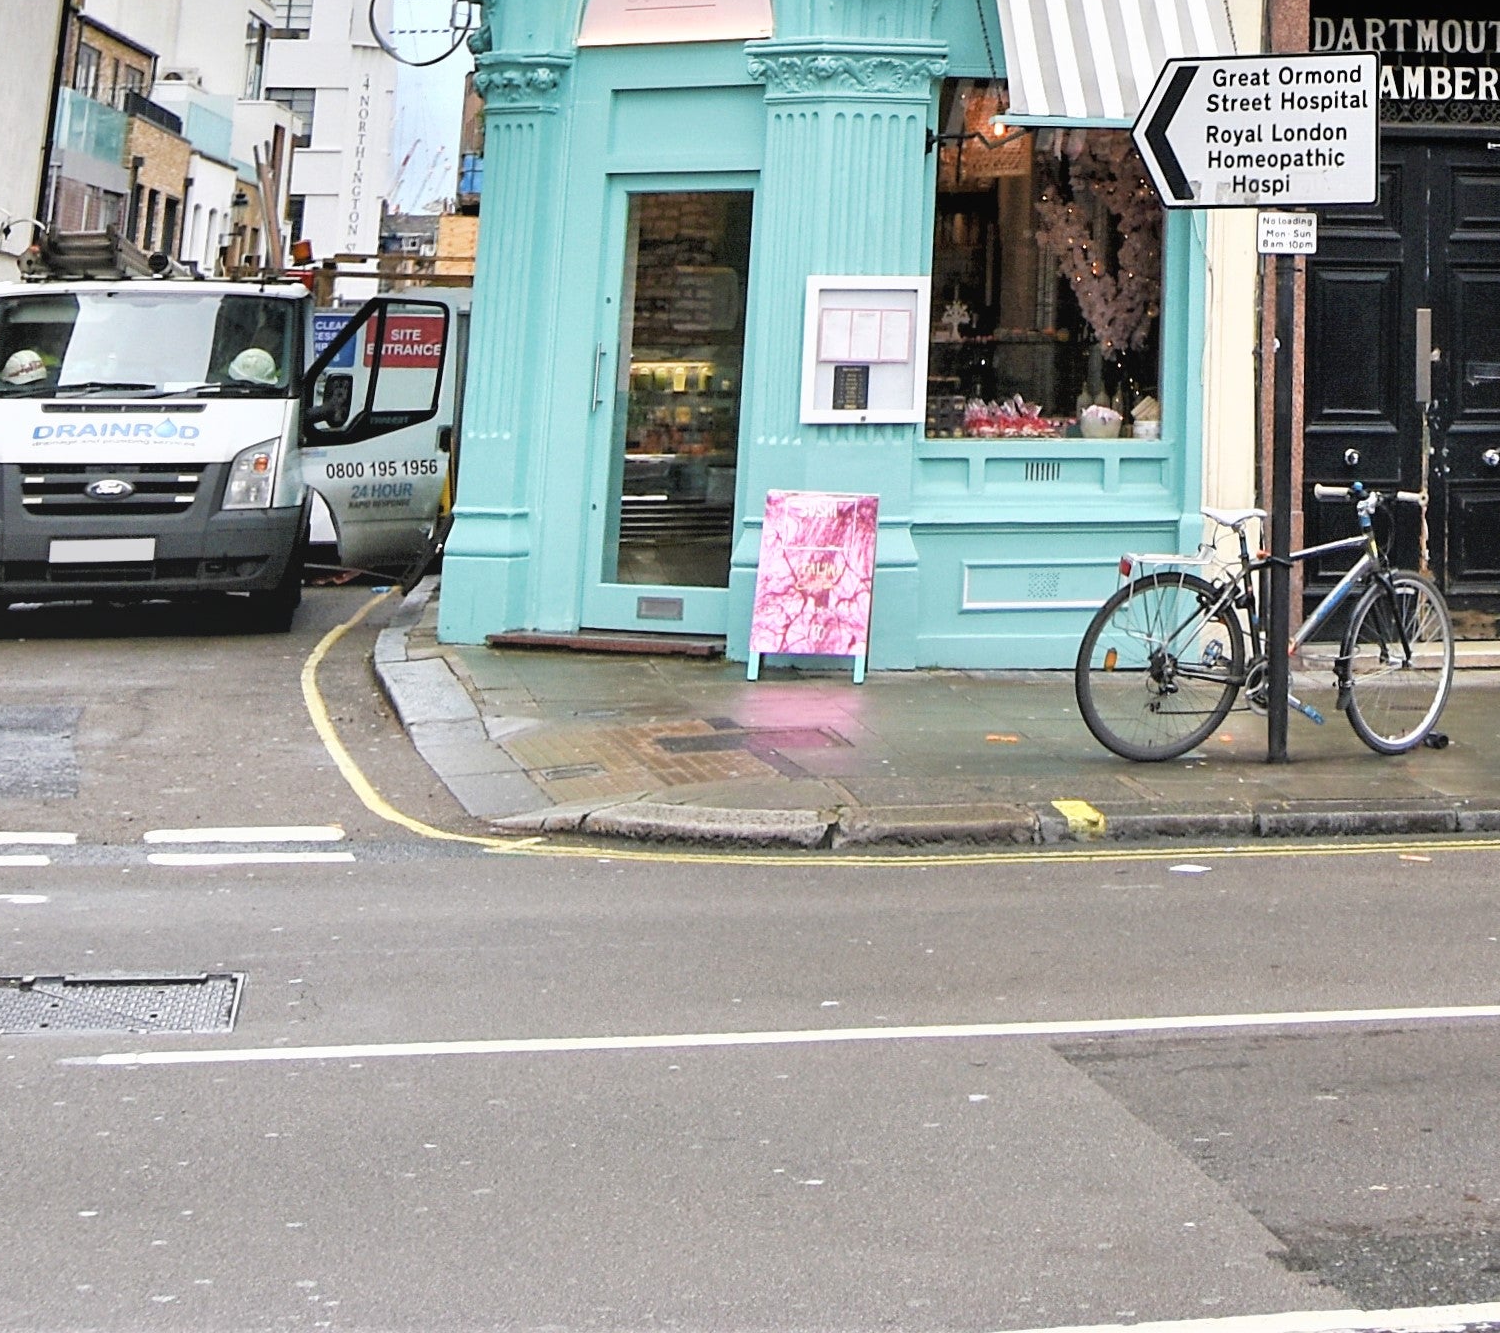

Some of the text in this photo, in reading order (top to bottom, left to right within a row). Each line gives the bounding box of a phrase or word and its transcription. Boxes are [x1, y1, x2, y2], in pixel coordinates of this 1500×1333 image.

[1212, 64, 1362, 88] Great Ormond
[1206, 89, 1368, 113] Street Hospital
[1206, 122, 1348, 146] Royal London
[347, 95, 371, 236] NORTHINGTON
[1208, 148, 1346, 171] Homeopathic
[1262, 217, 1313, 226] No loading
[1266, 229, 1312, 238] Mon Sun
[390, 328, 422, 341] SITE
[326, 459, 438, 479] 0800 195 1956
[351, 483, 413, 499] 24 HOUR
